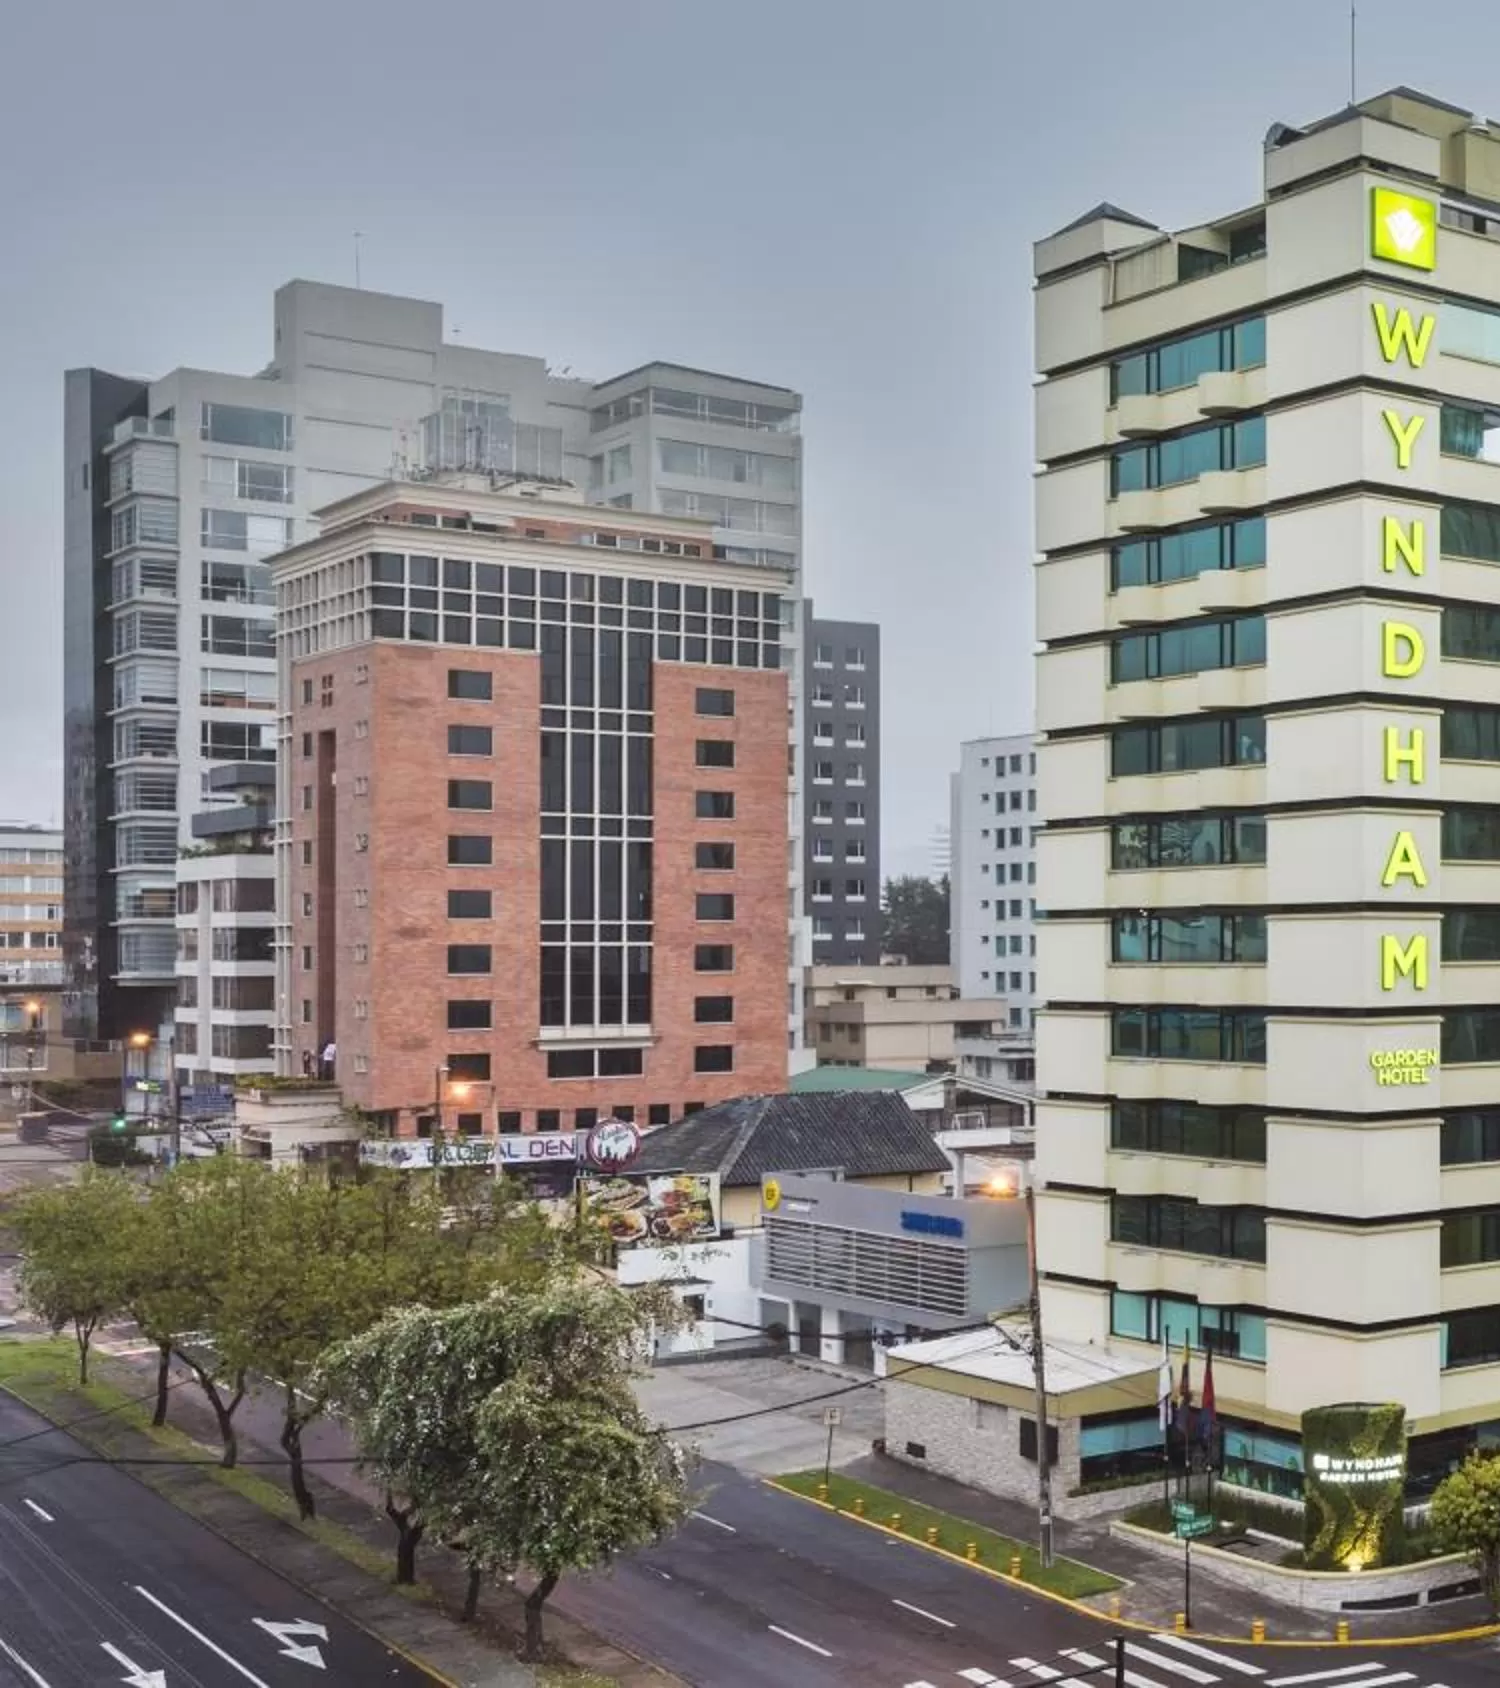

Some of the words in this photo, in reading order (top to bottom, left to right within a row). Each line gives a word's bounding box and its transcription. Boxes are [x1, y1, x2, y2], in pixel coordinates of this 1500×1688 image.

[1371, 302, 1435, 990] WYNDHAM
[1369, 1048, 1438, 1068] GARDEN
[1377, 1066, 1431, 1086] HOTEL
[529, 1138, 575, 1158] DEN
